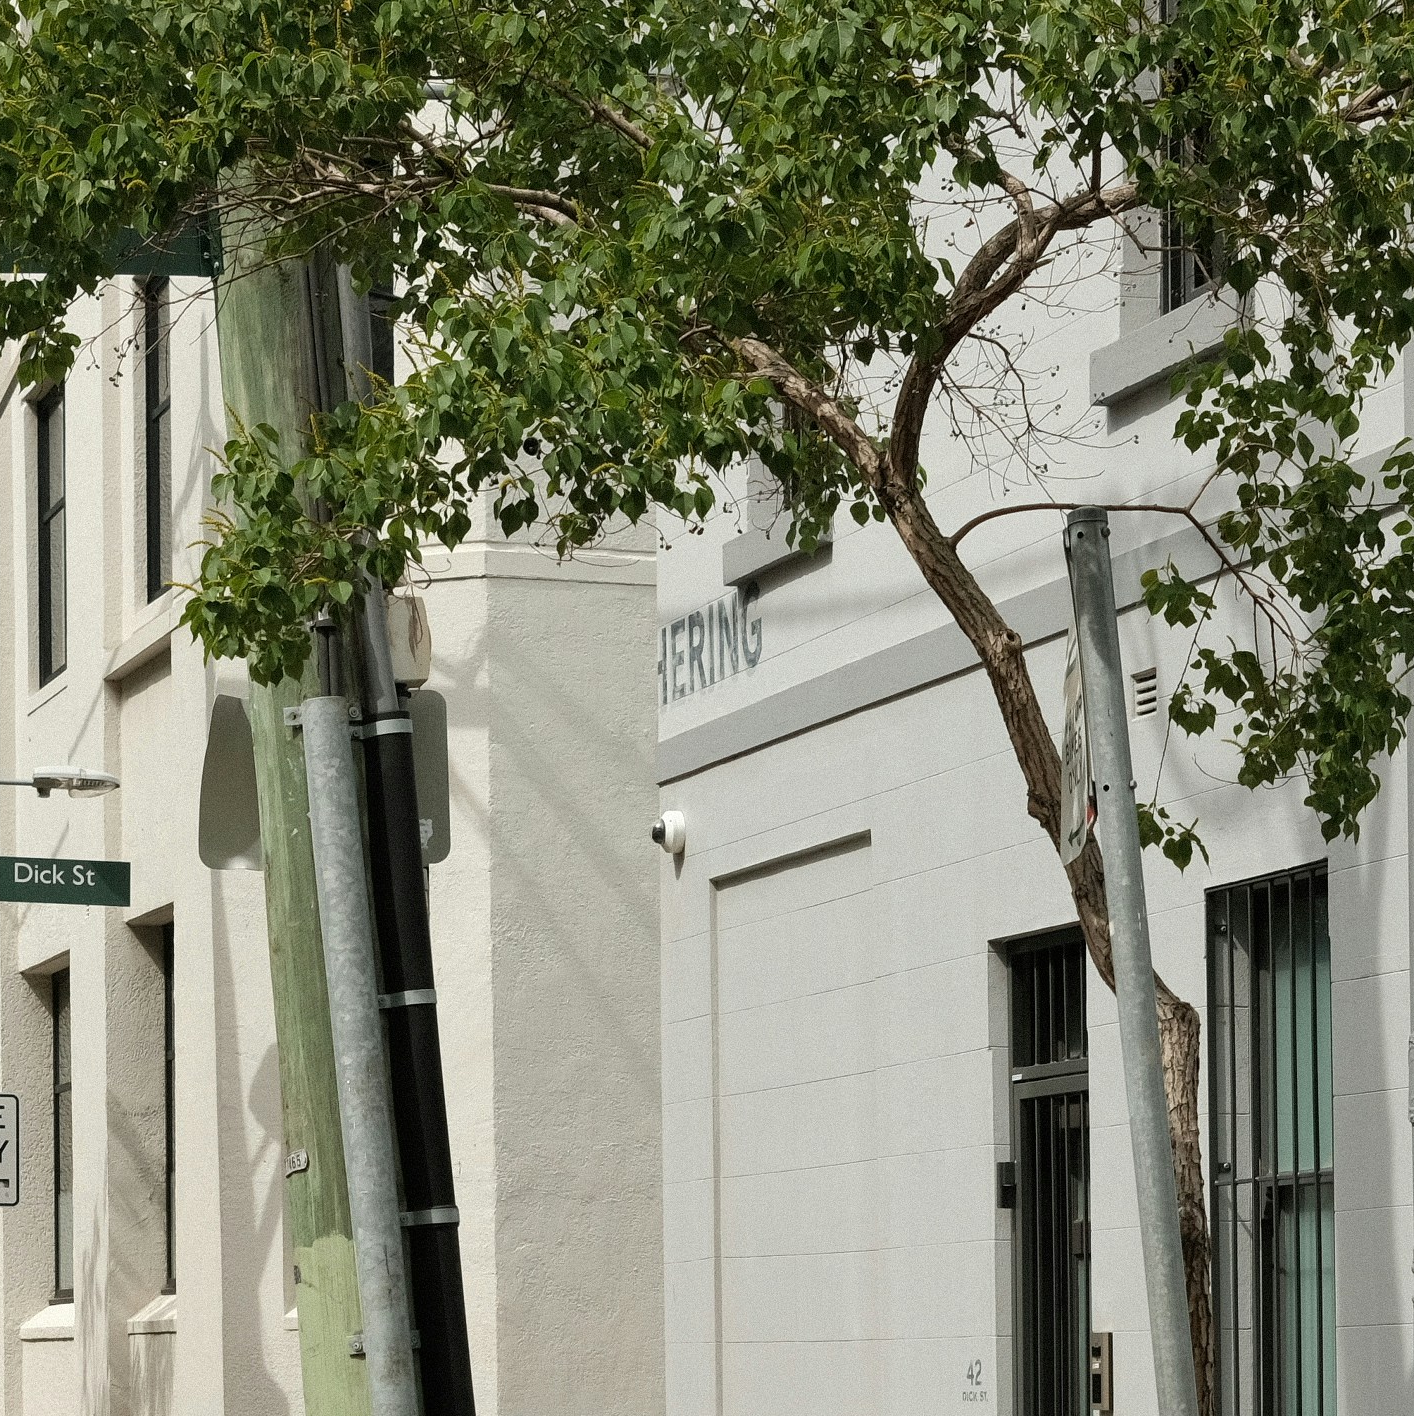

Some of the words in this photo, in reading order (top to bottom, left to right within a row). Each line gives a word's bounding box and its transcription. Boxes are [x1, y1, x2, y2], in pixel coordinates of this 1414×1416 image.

[14, 862, 65, 885] Dick
[72, 865, 96, 886] St
[966, 1359, 982, 1386] 42
[962, 1391, 978, 1402] DICK
